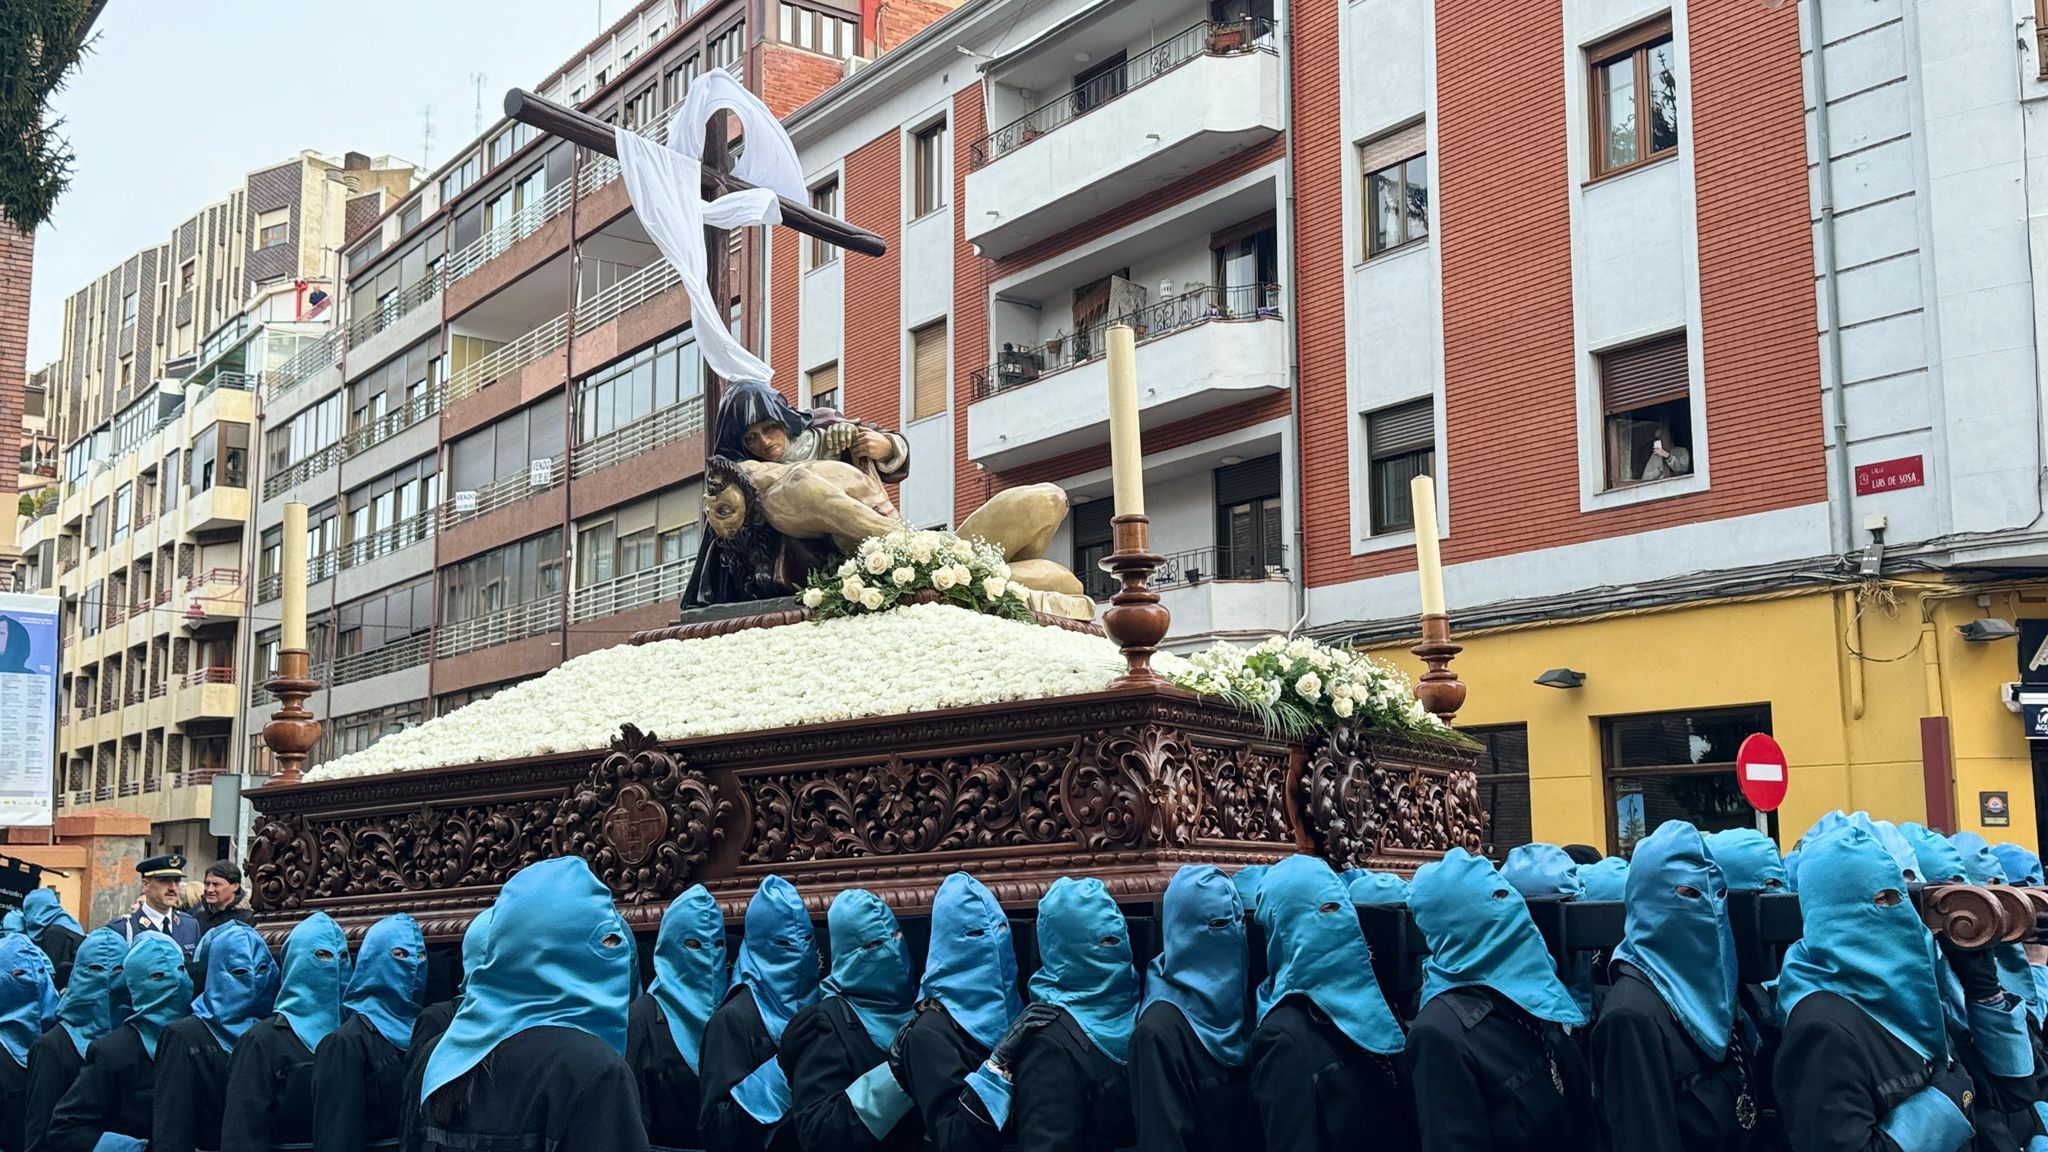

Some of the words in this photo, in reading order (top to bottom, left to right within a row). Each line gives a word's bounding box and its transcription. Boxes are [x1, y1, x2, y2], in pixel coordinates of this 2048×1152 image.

[1871, 477, 1886, 489] LUIS
[1887, 475, 1897, 486] DE
[1898, 472, 1917, 485] SOSA
